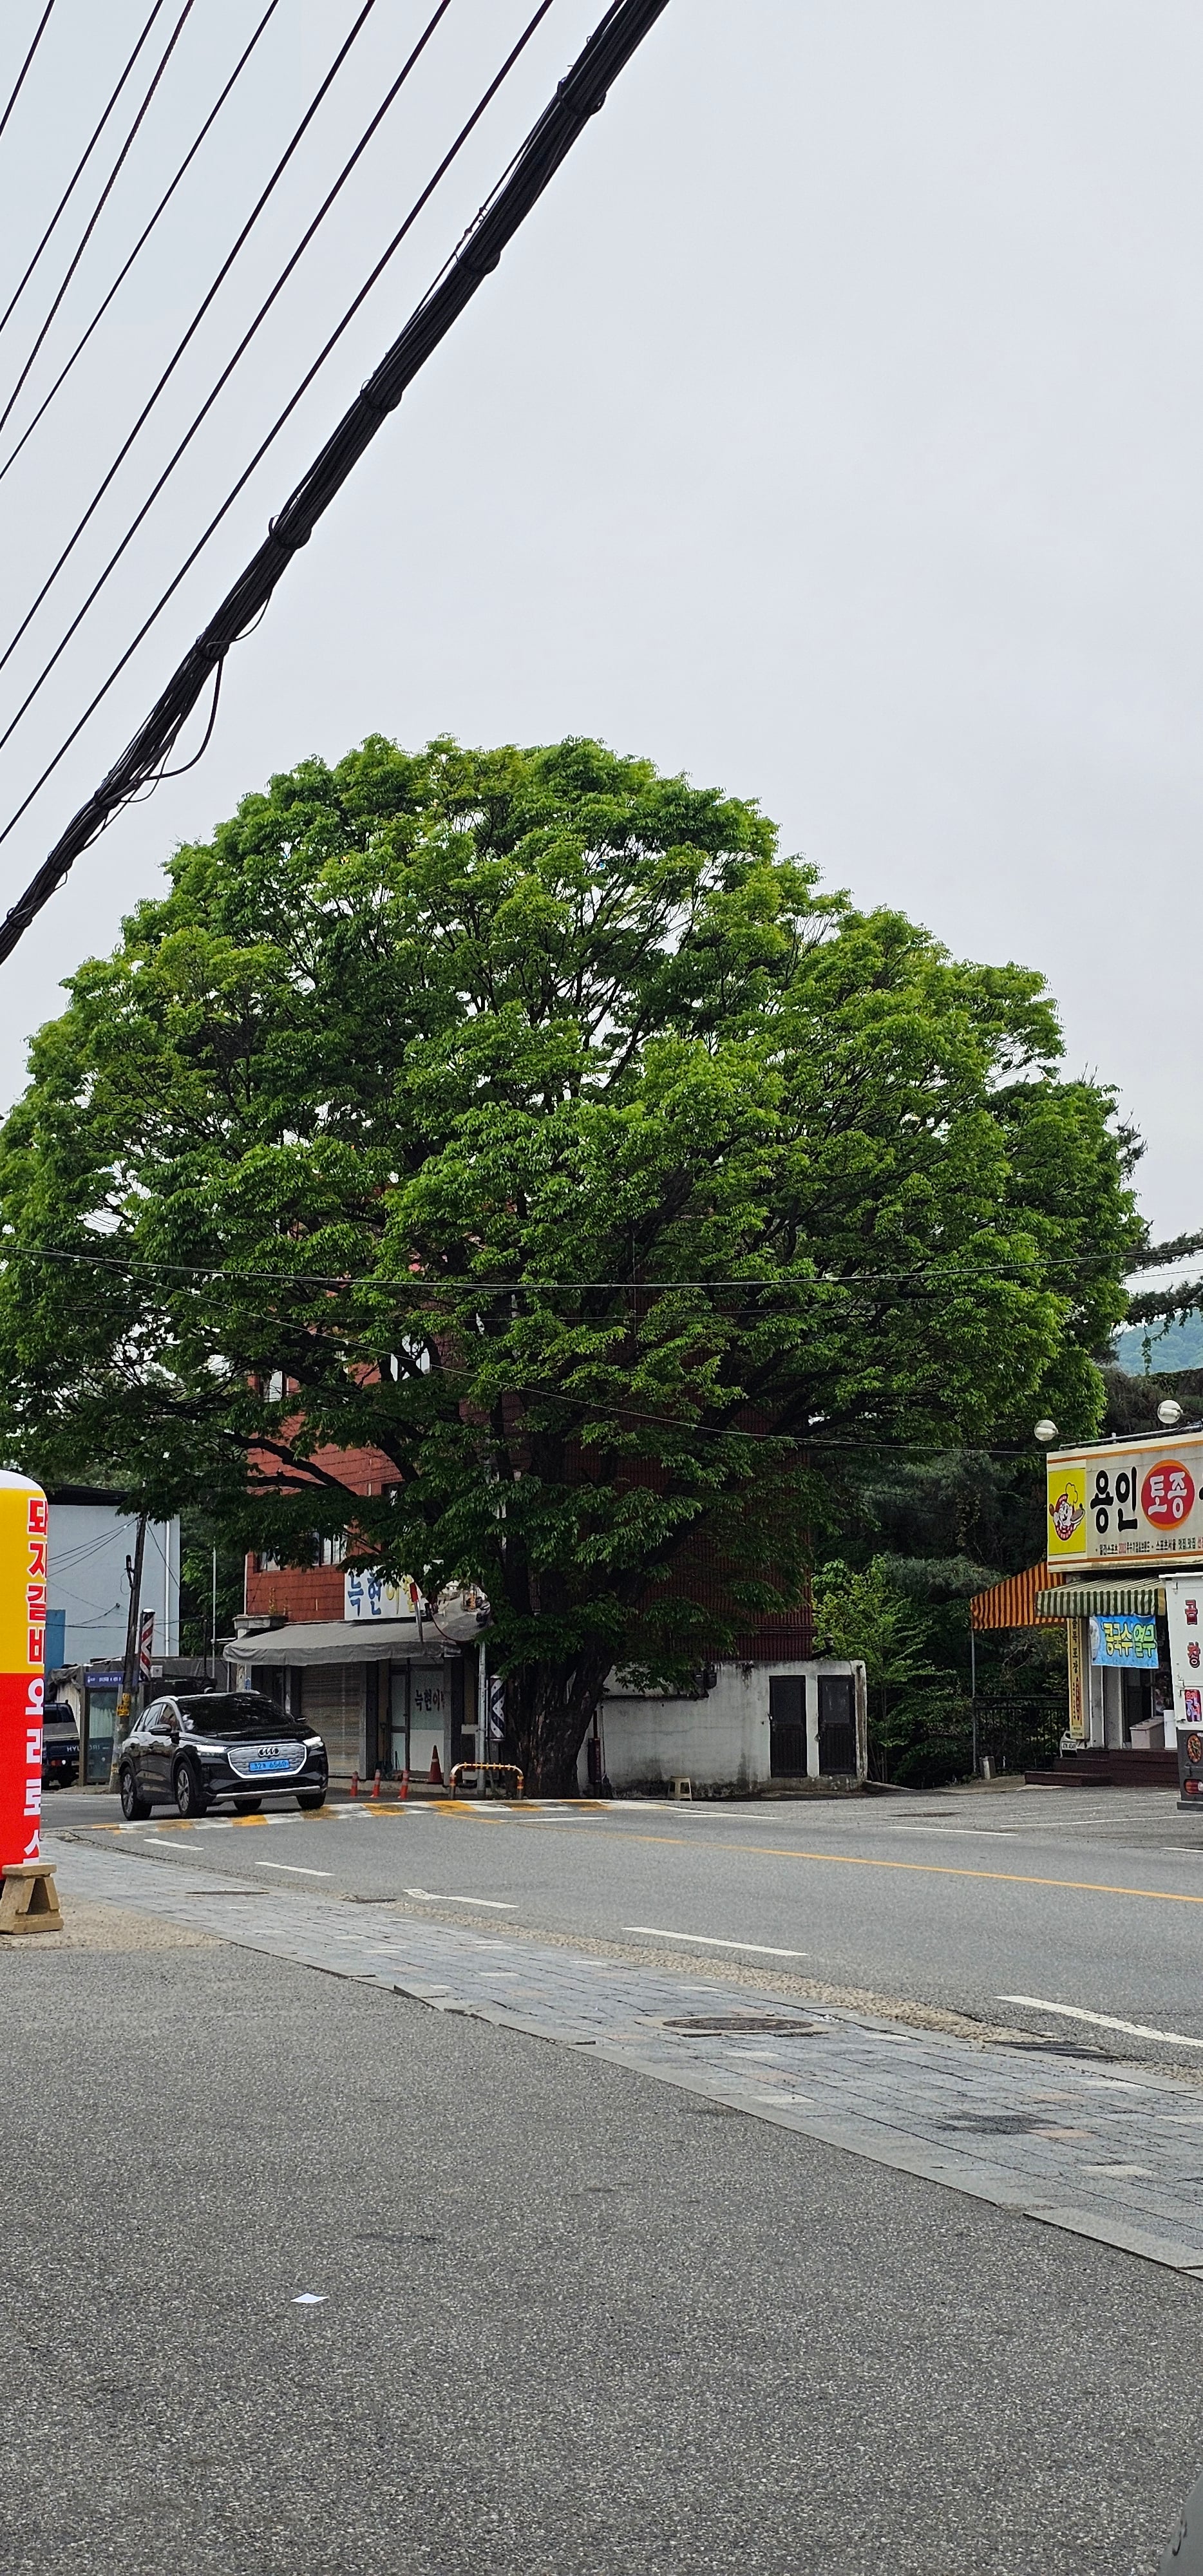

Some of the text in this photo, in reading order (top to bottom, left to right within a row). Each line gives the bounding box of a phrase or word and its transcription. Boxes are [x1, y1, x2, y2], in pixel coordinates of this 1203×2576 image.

[1090, 1466, 1188, 1534] 용인 토종
[1155, 1538, 1176, 1551] 스포츠서울
[27, 1499, 48, 1663] 돼지갈비
[1103, 1622, 1157, 1658] 콩국수 열무
